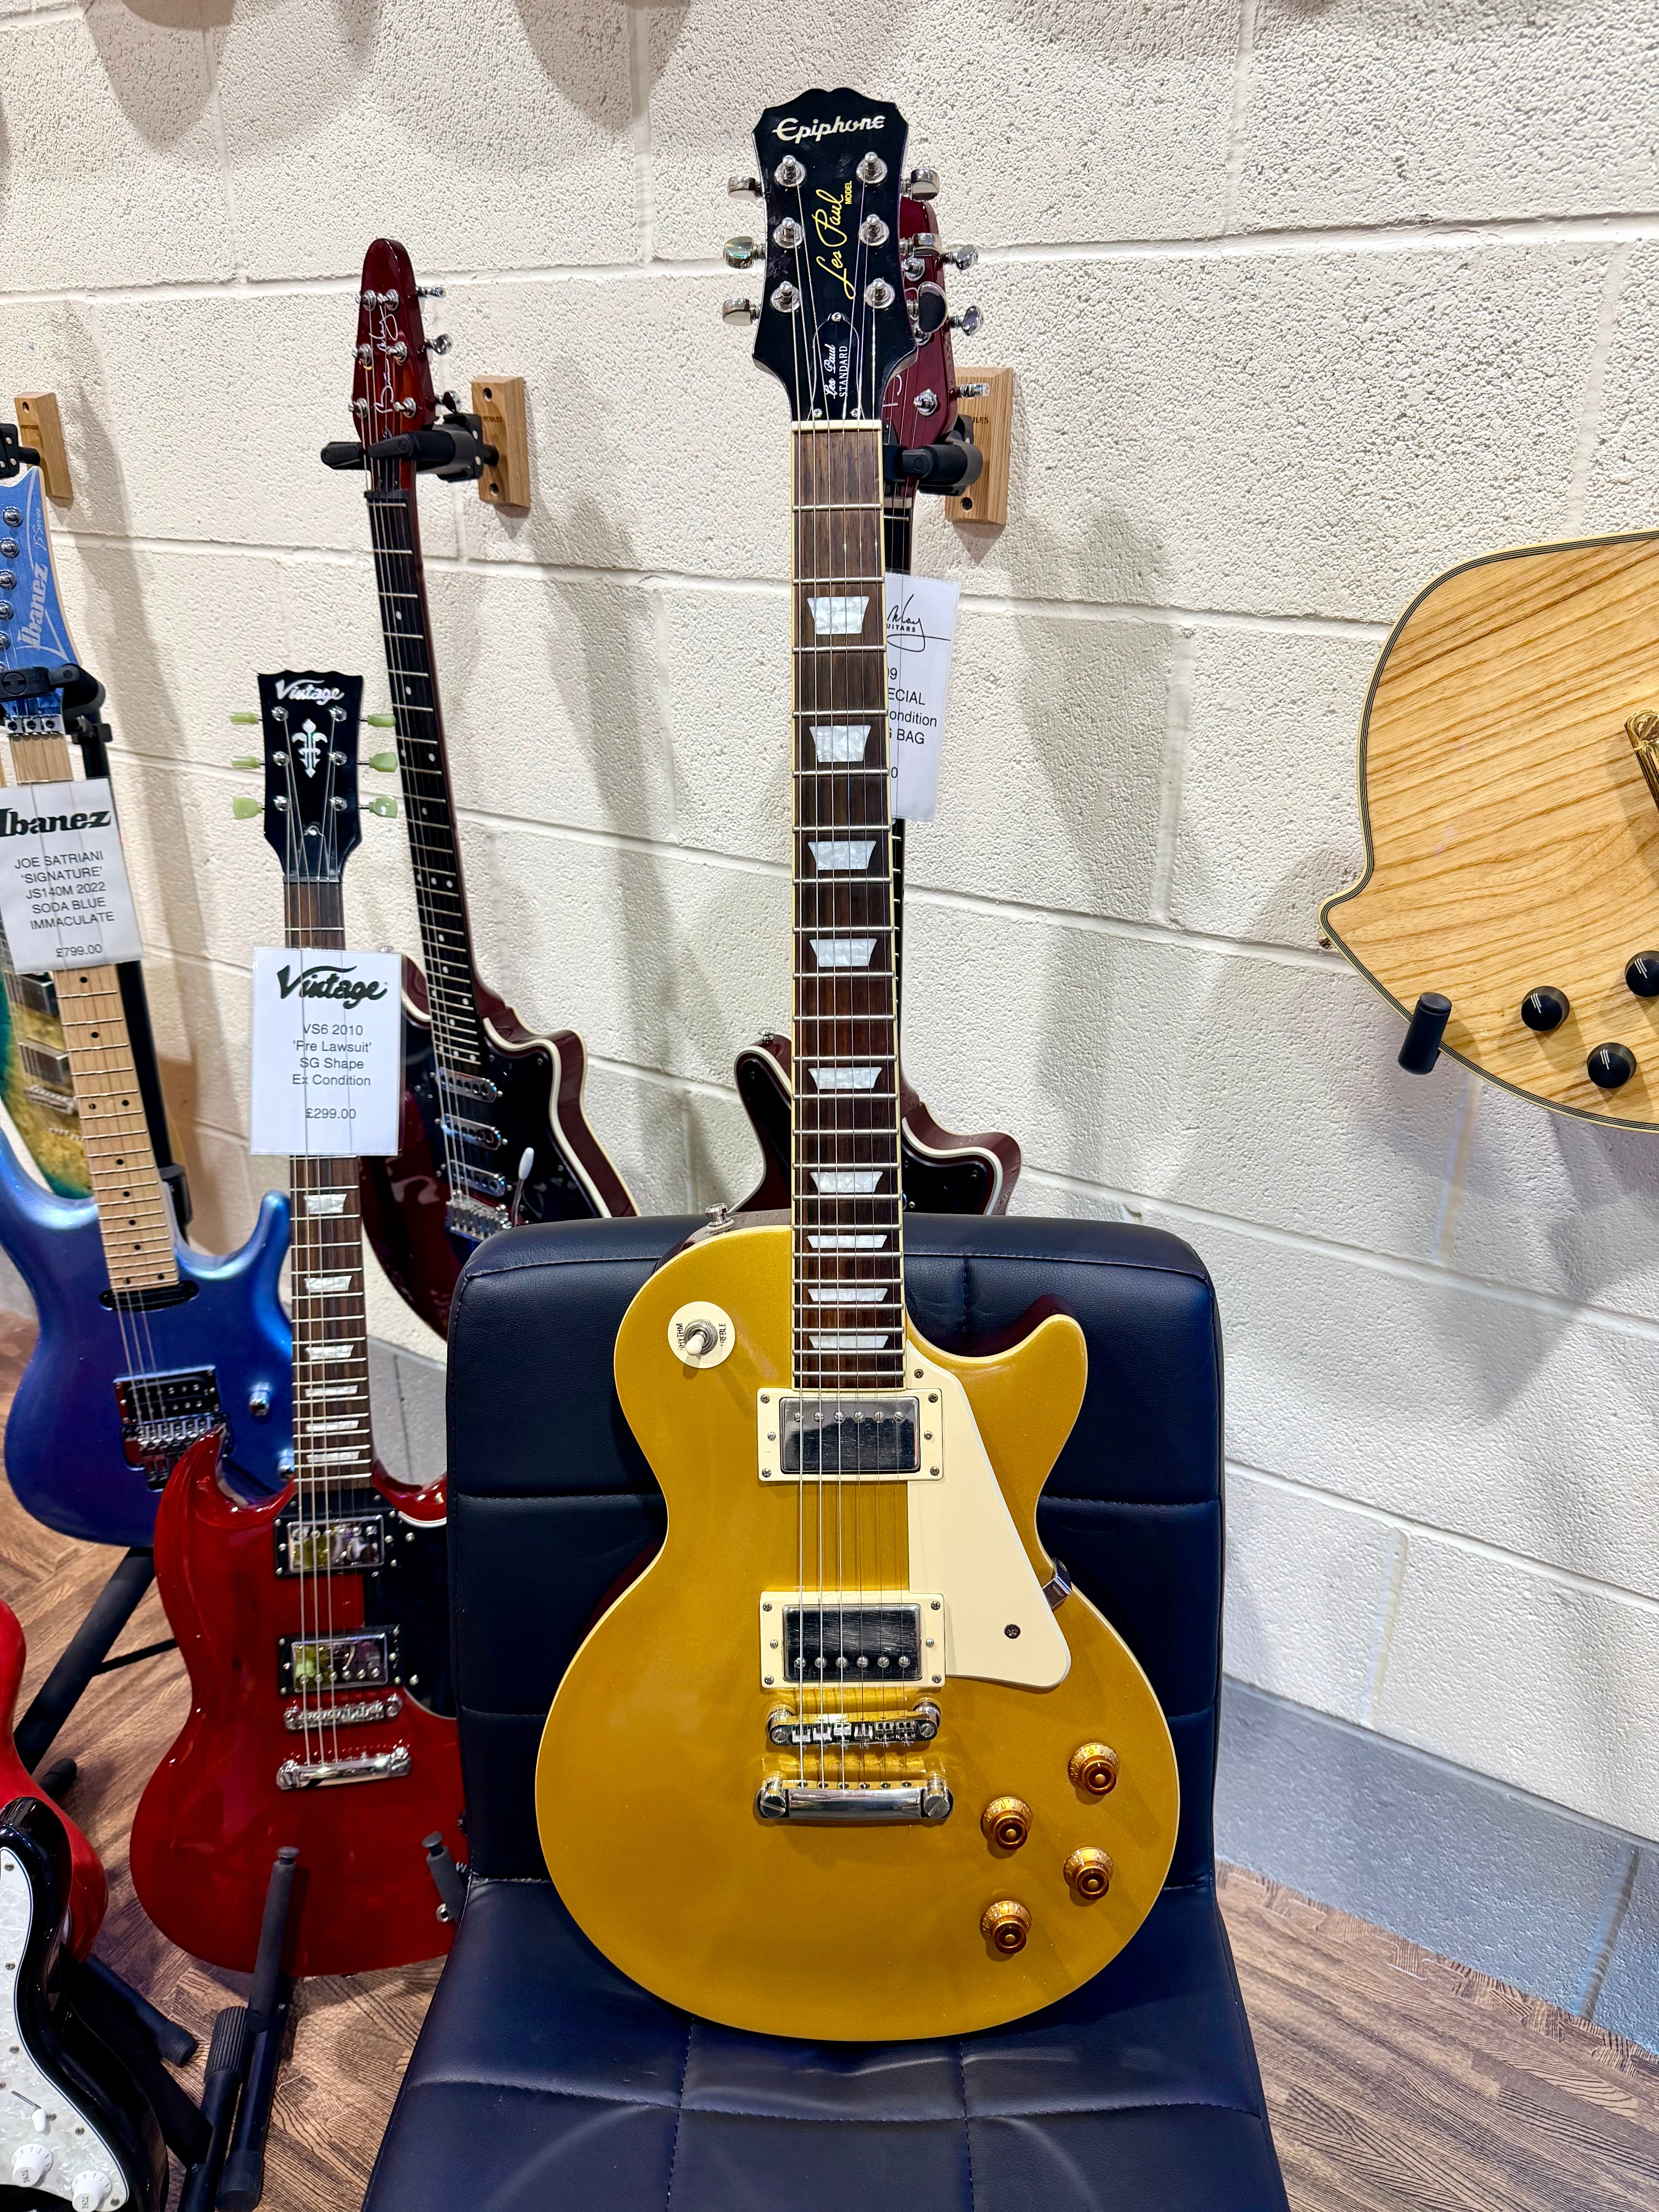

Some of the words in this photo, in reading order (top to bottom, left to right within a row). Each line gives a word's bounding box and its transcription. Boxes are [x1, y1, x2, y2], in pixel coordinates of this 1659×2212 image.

[772, 115, 886, 144] Epiphone
[812, 189, 847, 247] Paul
[816, 250, 856, 300] Les
[824, 343, 836, 374] Paul
[839, 346, 848, 397] STANDARD
[824, 378, 838, 399] Les
[17, 562, 48, 651] Ibanez
[275, 678, 345, 706] Vintage
[897, 728, 924, 744] BAG
[0, 808, 111, 837] Ibanez
[15, 856, 40, 869] JOE
[44, 850, 104, 866] SATRIANI
[26, 886, 74, 899] JS140M
[76, 881, 106, 894] 2022
[32, 901, 69, 914] SODA
[72, 897, 106, 910] BLUE
[30, 911, 115, 930] IMMACULATE
[56, 944, 102, 958] £799.00
[277, 964, 387, 1010] Vintage
[303, 1024, 328, 1035] VS6
[333, 1025, 363, 1036] 2010
[300, 1057, 319, 1068] SG
[324, 1058, 364, 1072] Shape
[293, 1074, 308, 1085] Ex
[313, 1074, 371, 1086] Condition
[306, 1108, 356, 1119] £299.00
[676, 1323, 685, 1351] RHYTHM
[21, 2170, 30, 2183] TONE
